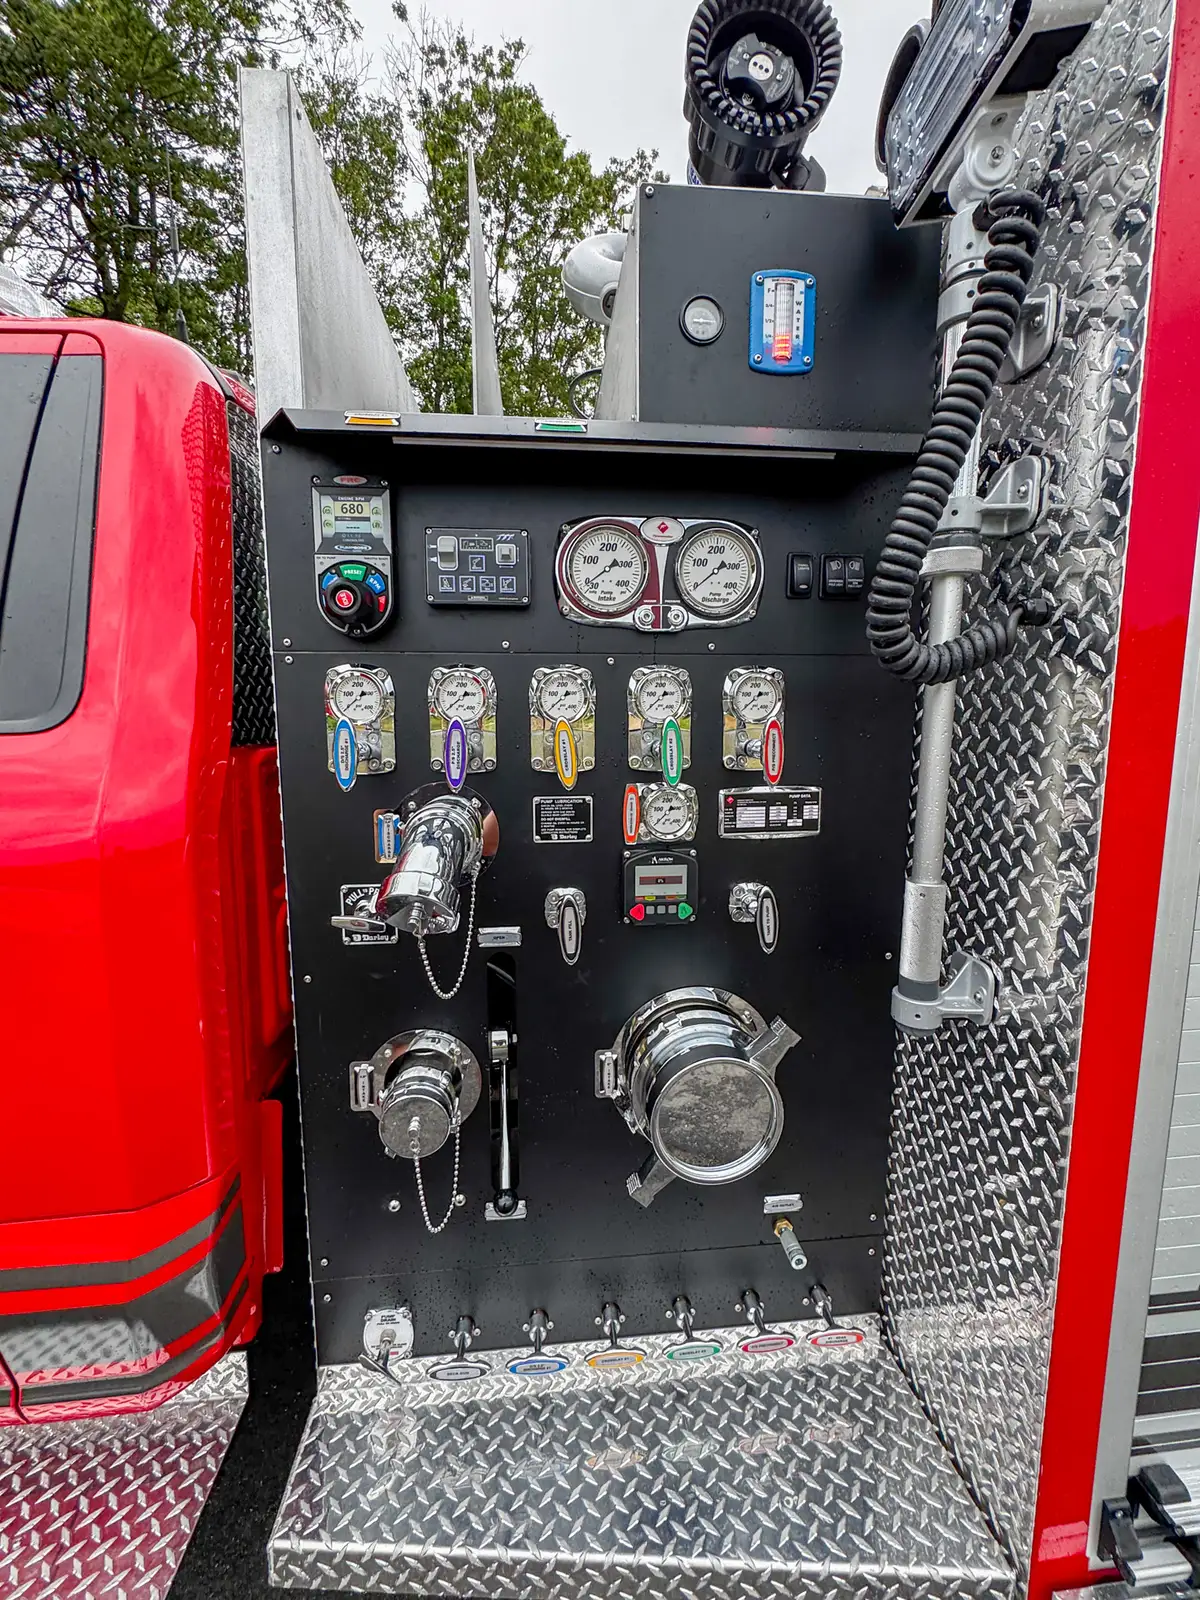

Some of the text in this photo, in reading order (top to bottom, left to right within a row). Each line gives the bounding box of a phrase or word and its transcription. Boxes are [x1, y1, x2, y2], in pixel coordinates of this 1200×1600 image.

[340, 503, 364, 514] 680
[599, 542, 617, 552] 200
[707, 546, 725, 554] 200
[583, 555, 599, 564] 100
[692, 558, 708, 567] 100
[369, 577, 382, 590] RPM
[345, 889, 365, 906] PULL
